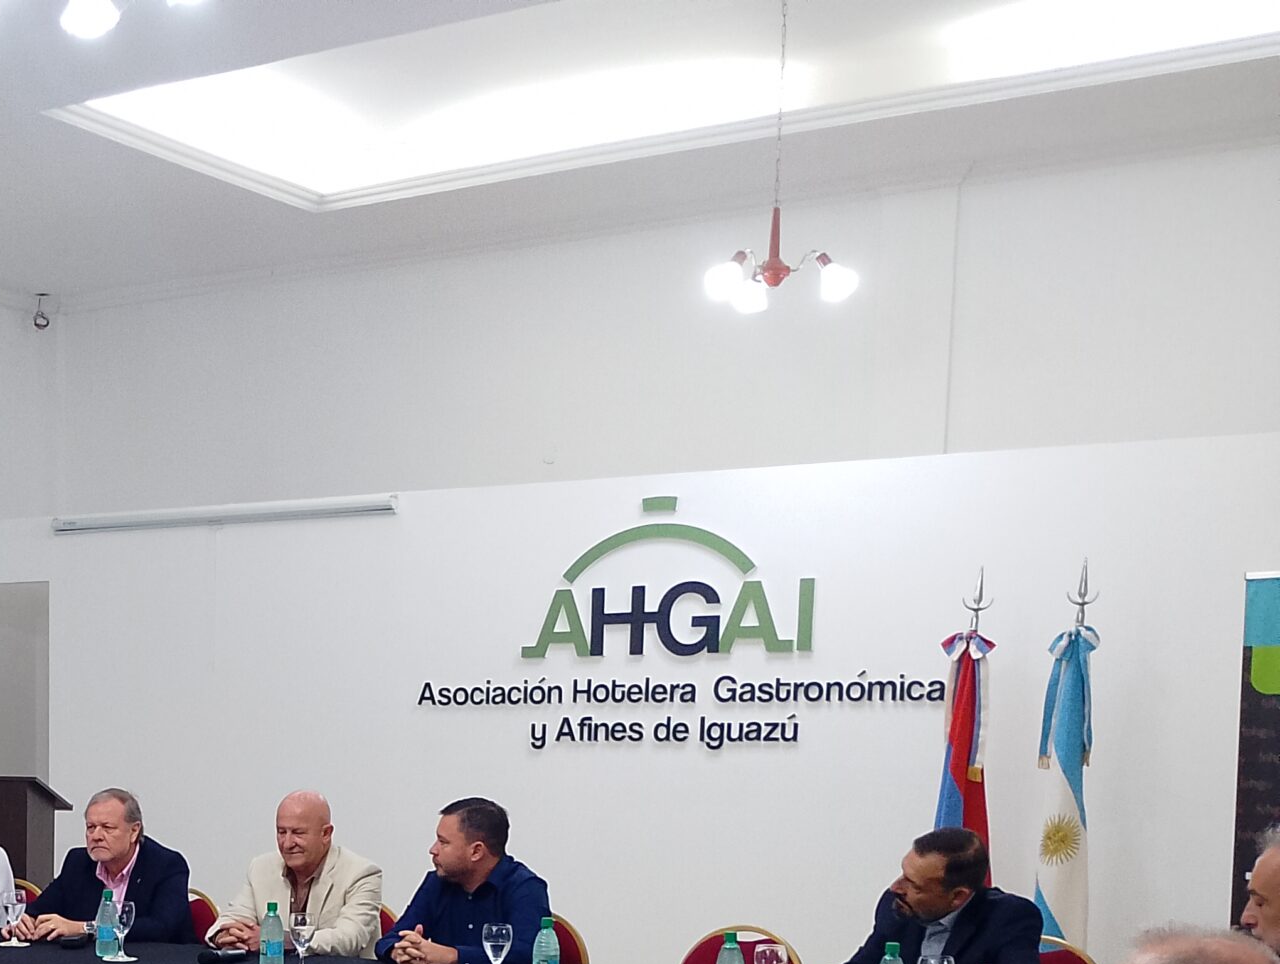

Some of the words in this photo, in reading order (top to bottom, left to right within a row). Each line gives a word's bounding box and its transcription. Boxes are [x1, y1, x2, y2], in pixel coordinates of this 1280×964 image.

[520, 577, 816, 659] AHGAI
[417, 678, 563, 707] Asociación
[572, 677, 697, 704] Hotelera
[713, 671, 946, 704] Gastronómica
[530, 720, 548, 750] y
[555, 715, 644, 743] Afines
[652, 716, 690, 743] de
[698, 714, 799, 750] Iguazú
